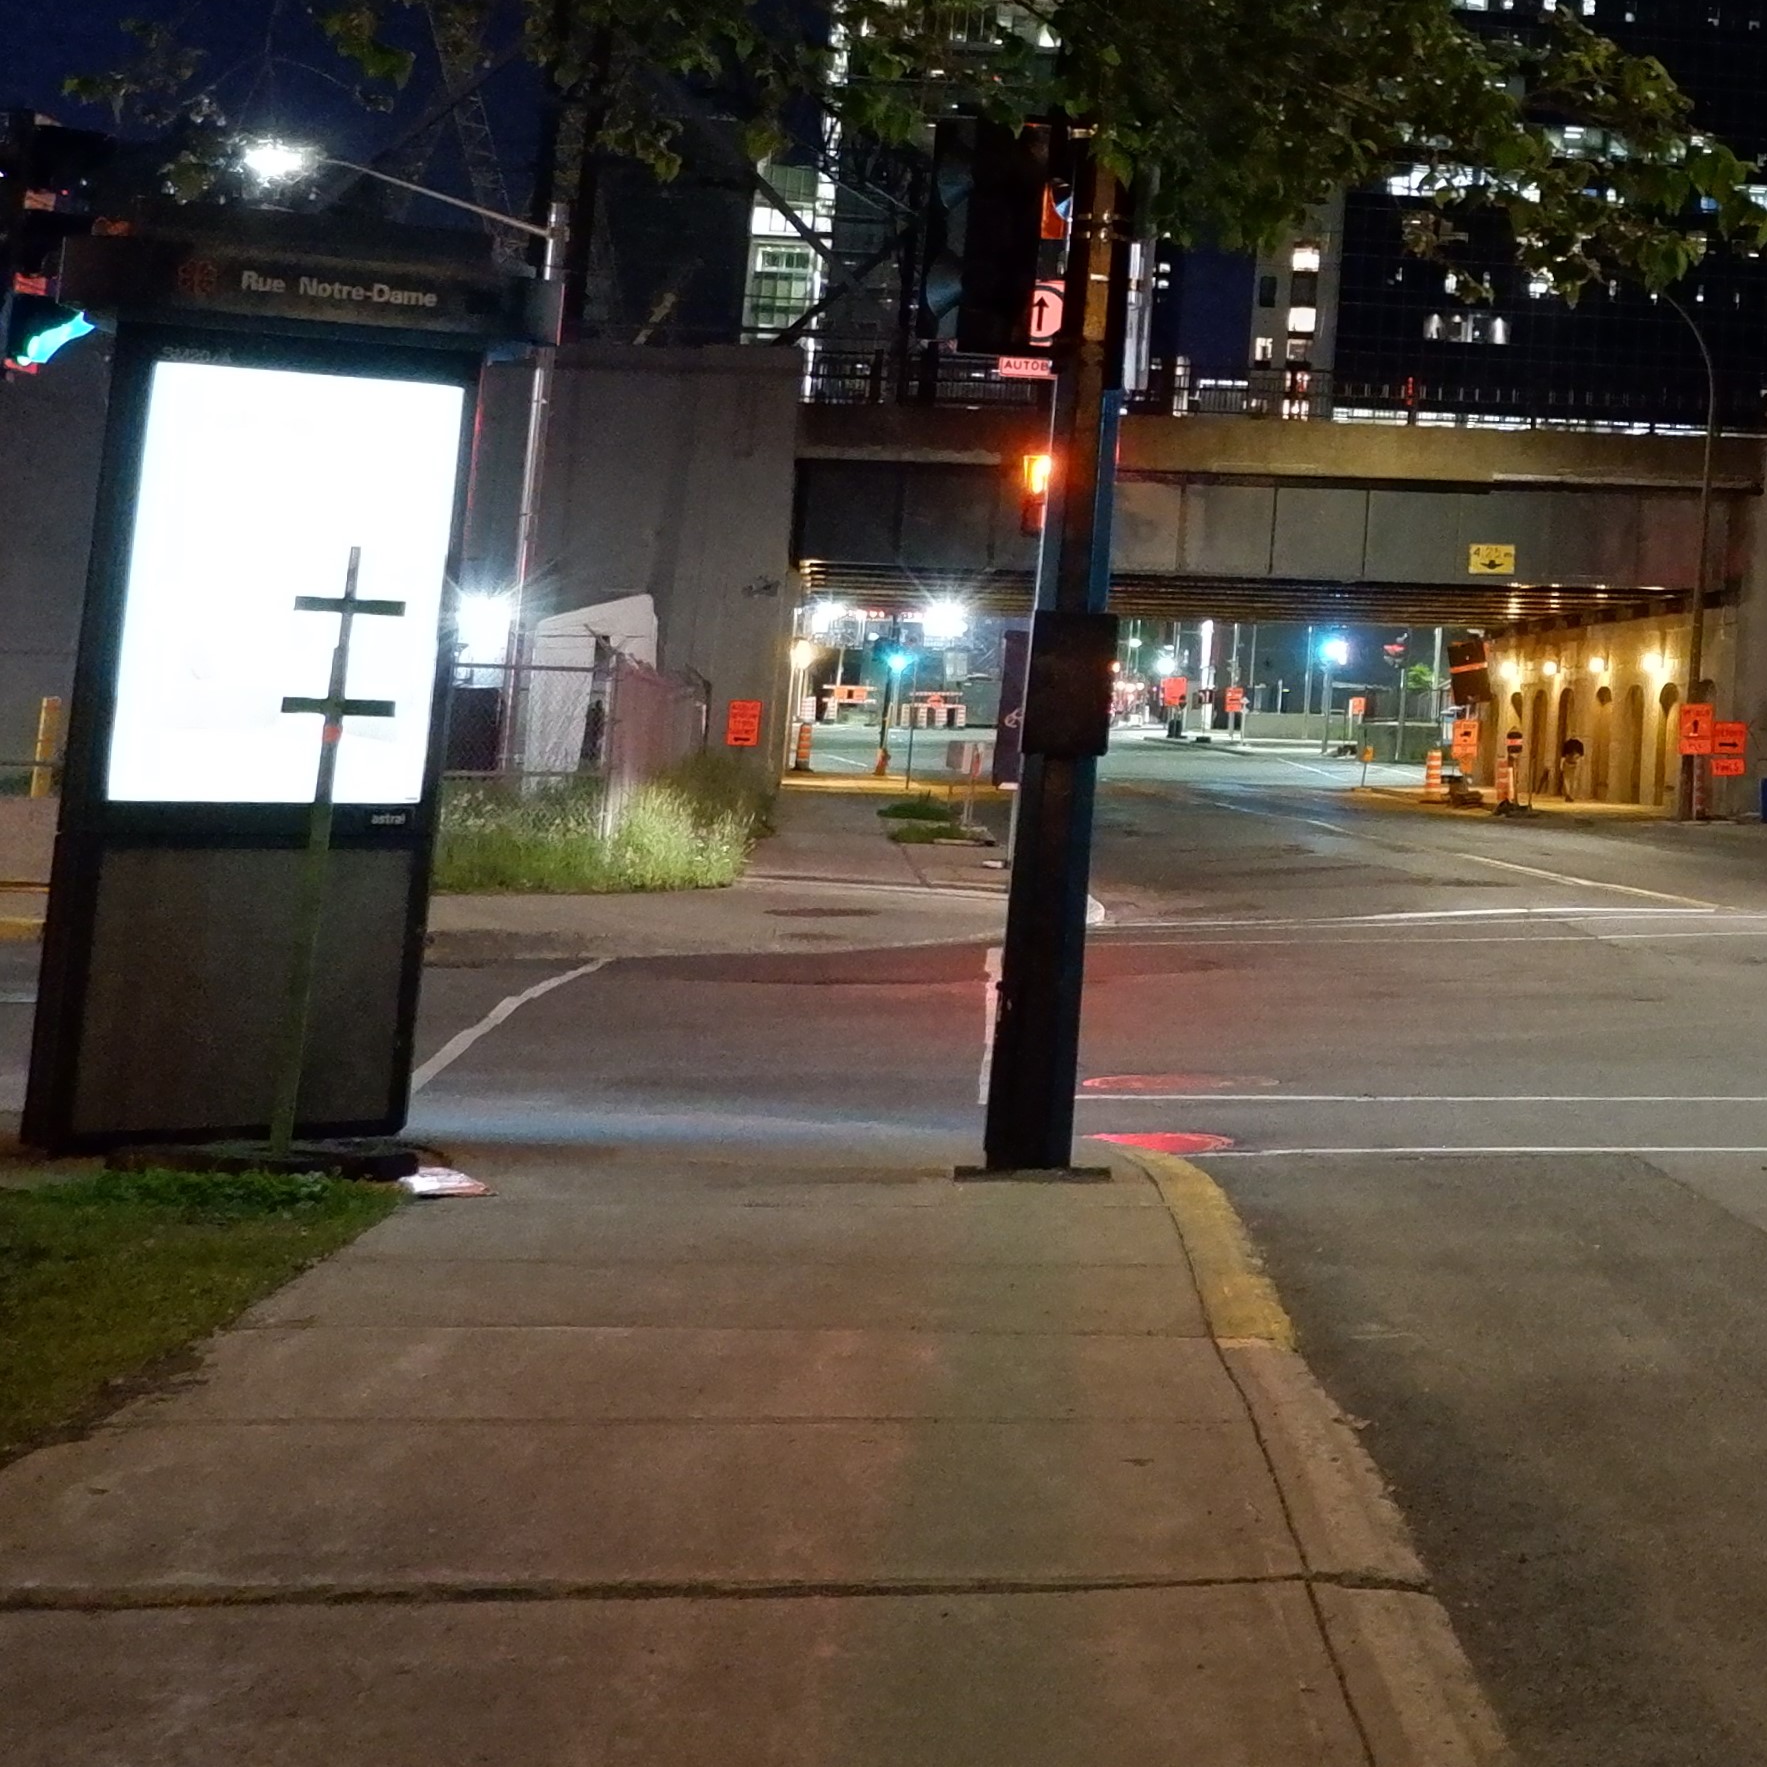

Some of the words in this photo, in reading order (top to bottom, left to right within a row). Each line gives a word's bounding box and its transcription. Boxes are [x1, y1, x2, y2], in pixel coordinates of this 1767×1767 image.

[240, 270, 286, 293] Rue
[299, 276, 438, 307] Notre-Dame
[1004, 360, 1049, 372] AUTOB
[371, 813, 406, 825] astral
